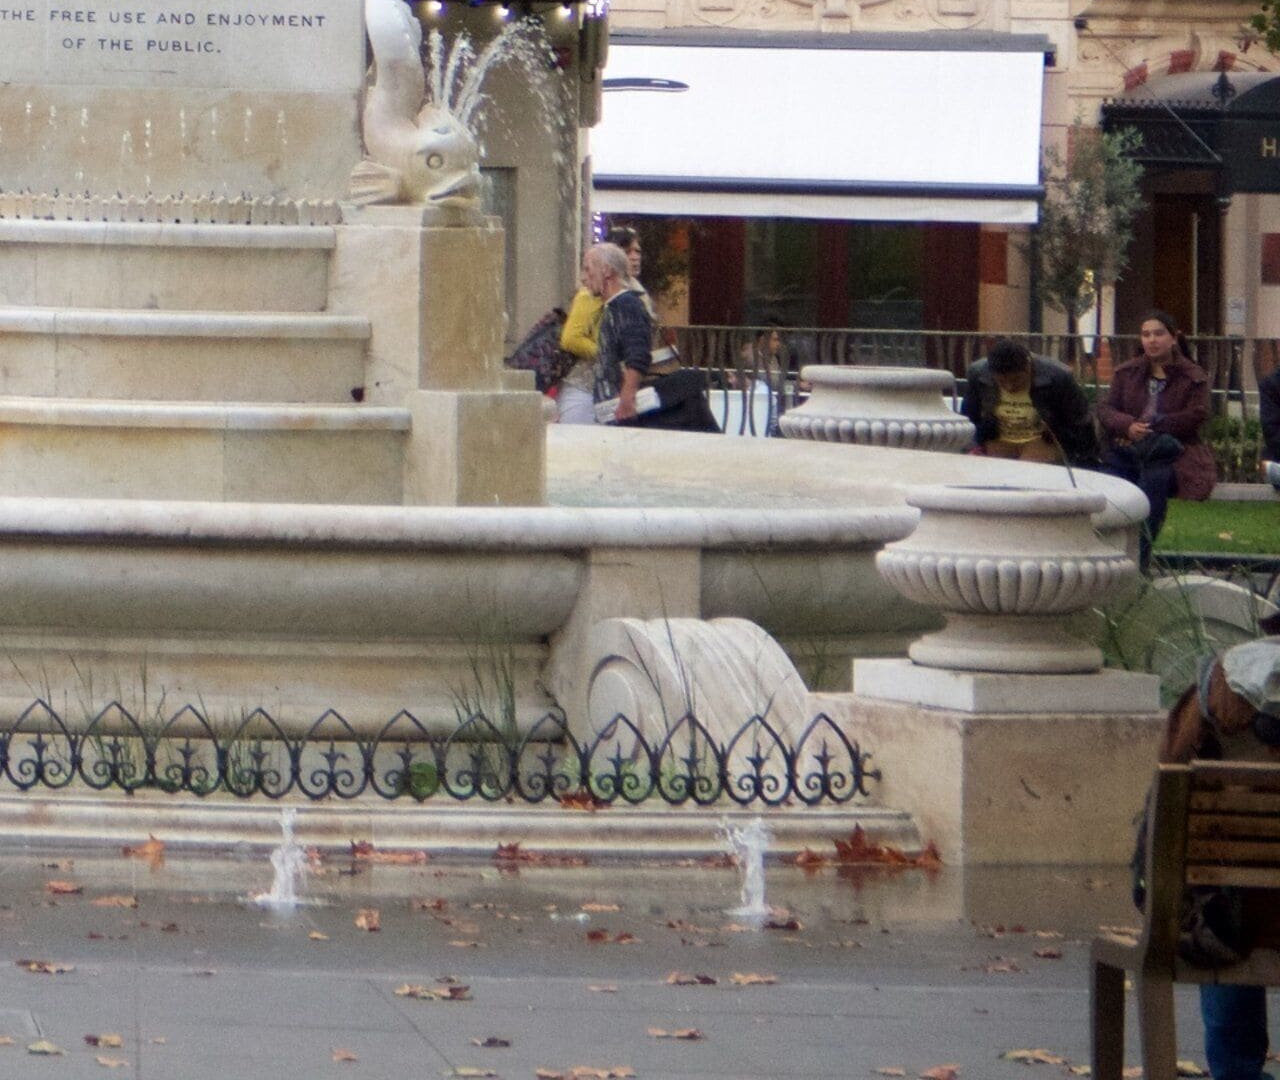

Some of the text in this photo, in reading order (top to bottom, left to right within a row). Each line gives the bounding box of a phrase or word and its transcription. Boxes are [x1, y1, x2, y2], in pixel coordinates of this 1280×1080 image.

[0, 10, 35, 21] THE
[50, 11, 96, 23] FREE
[109, 12, 146, 24] USE
[156, 13, 196, 25] AND
[207, 14, 326, 27] ENJOYMENT
[62, 38, 222, 53] OF THE PUBLIC.
